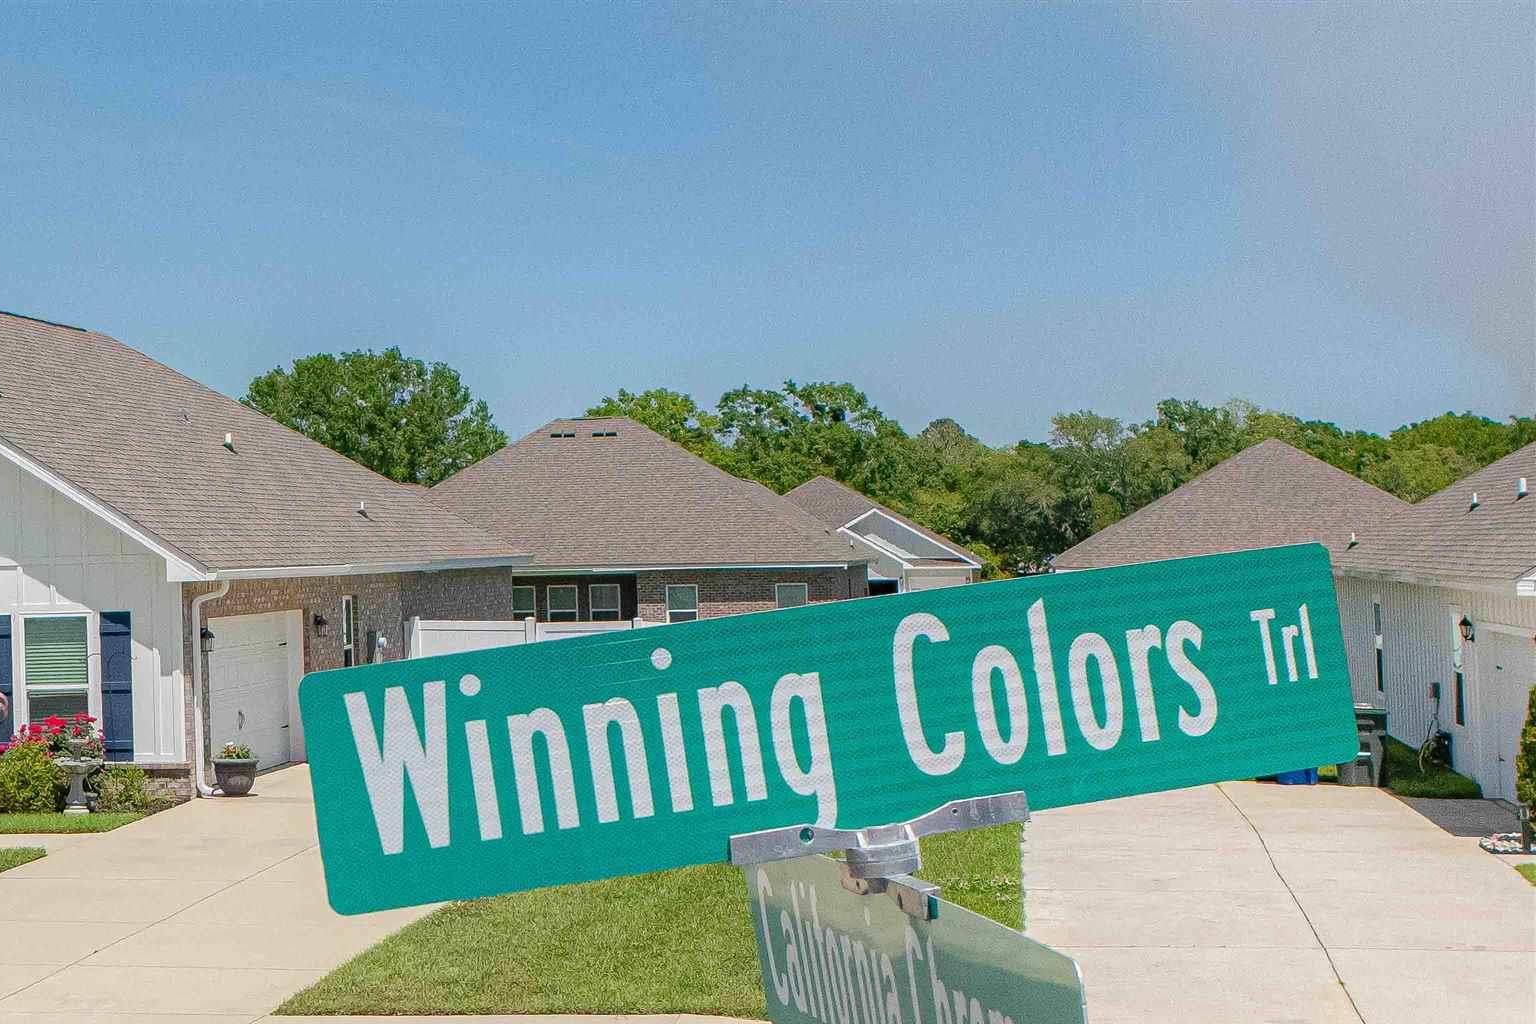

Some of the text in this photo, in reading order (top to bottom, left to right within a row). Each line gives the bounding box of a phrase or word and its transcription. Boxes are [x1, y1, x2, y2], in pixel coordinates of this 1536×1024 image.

[343, 597, 1319, 855] Winning Colors Trl
